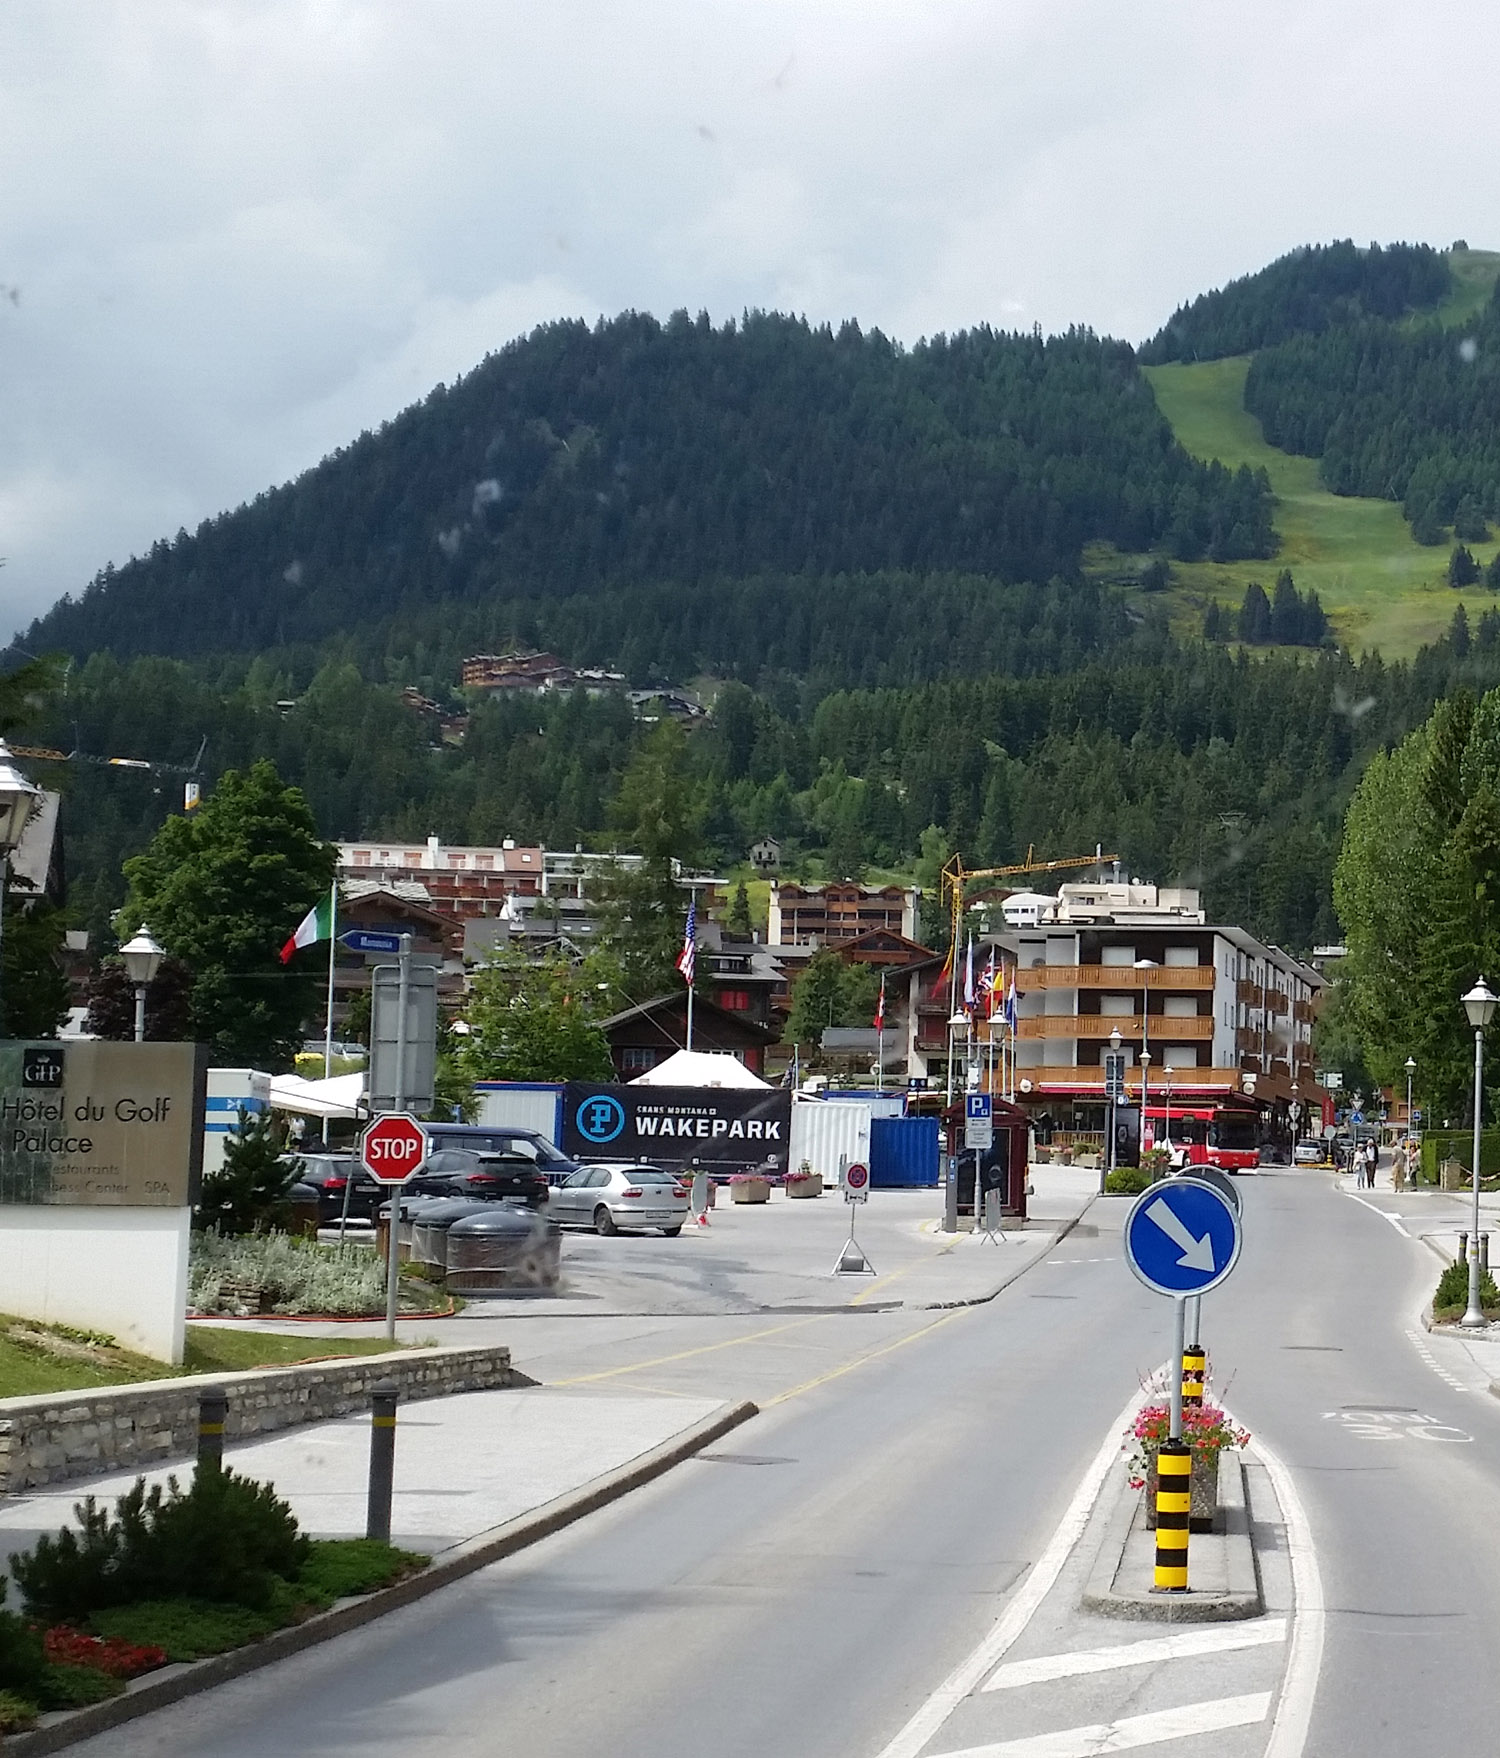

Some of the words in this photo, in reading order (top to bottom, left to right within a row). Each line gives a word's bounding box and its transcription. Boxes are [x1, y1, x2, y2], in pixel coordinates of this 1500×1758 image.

[2, 1096, 65, 1122] Hôtel
[74, 1096, 105, 1122] du
[115, 1097, 171, 1122] Golf
[636, 1105, 664, 1114] CRANS
[667, 1106, 707, 1116] MONTANA
[971, 1097, 983, 1115] P
[635, 1116, 781, 1140] WAKEPARK
[13, 1128, 93, 1153] Palace
[370, 1138, 418, 1160] STOP
[144, 1181, 170, 1194] SPA
[1341, 1424, 1475, 1442] 30
